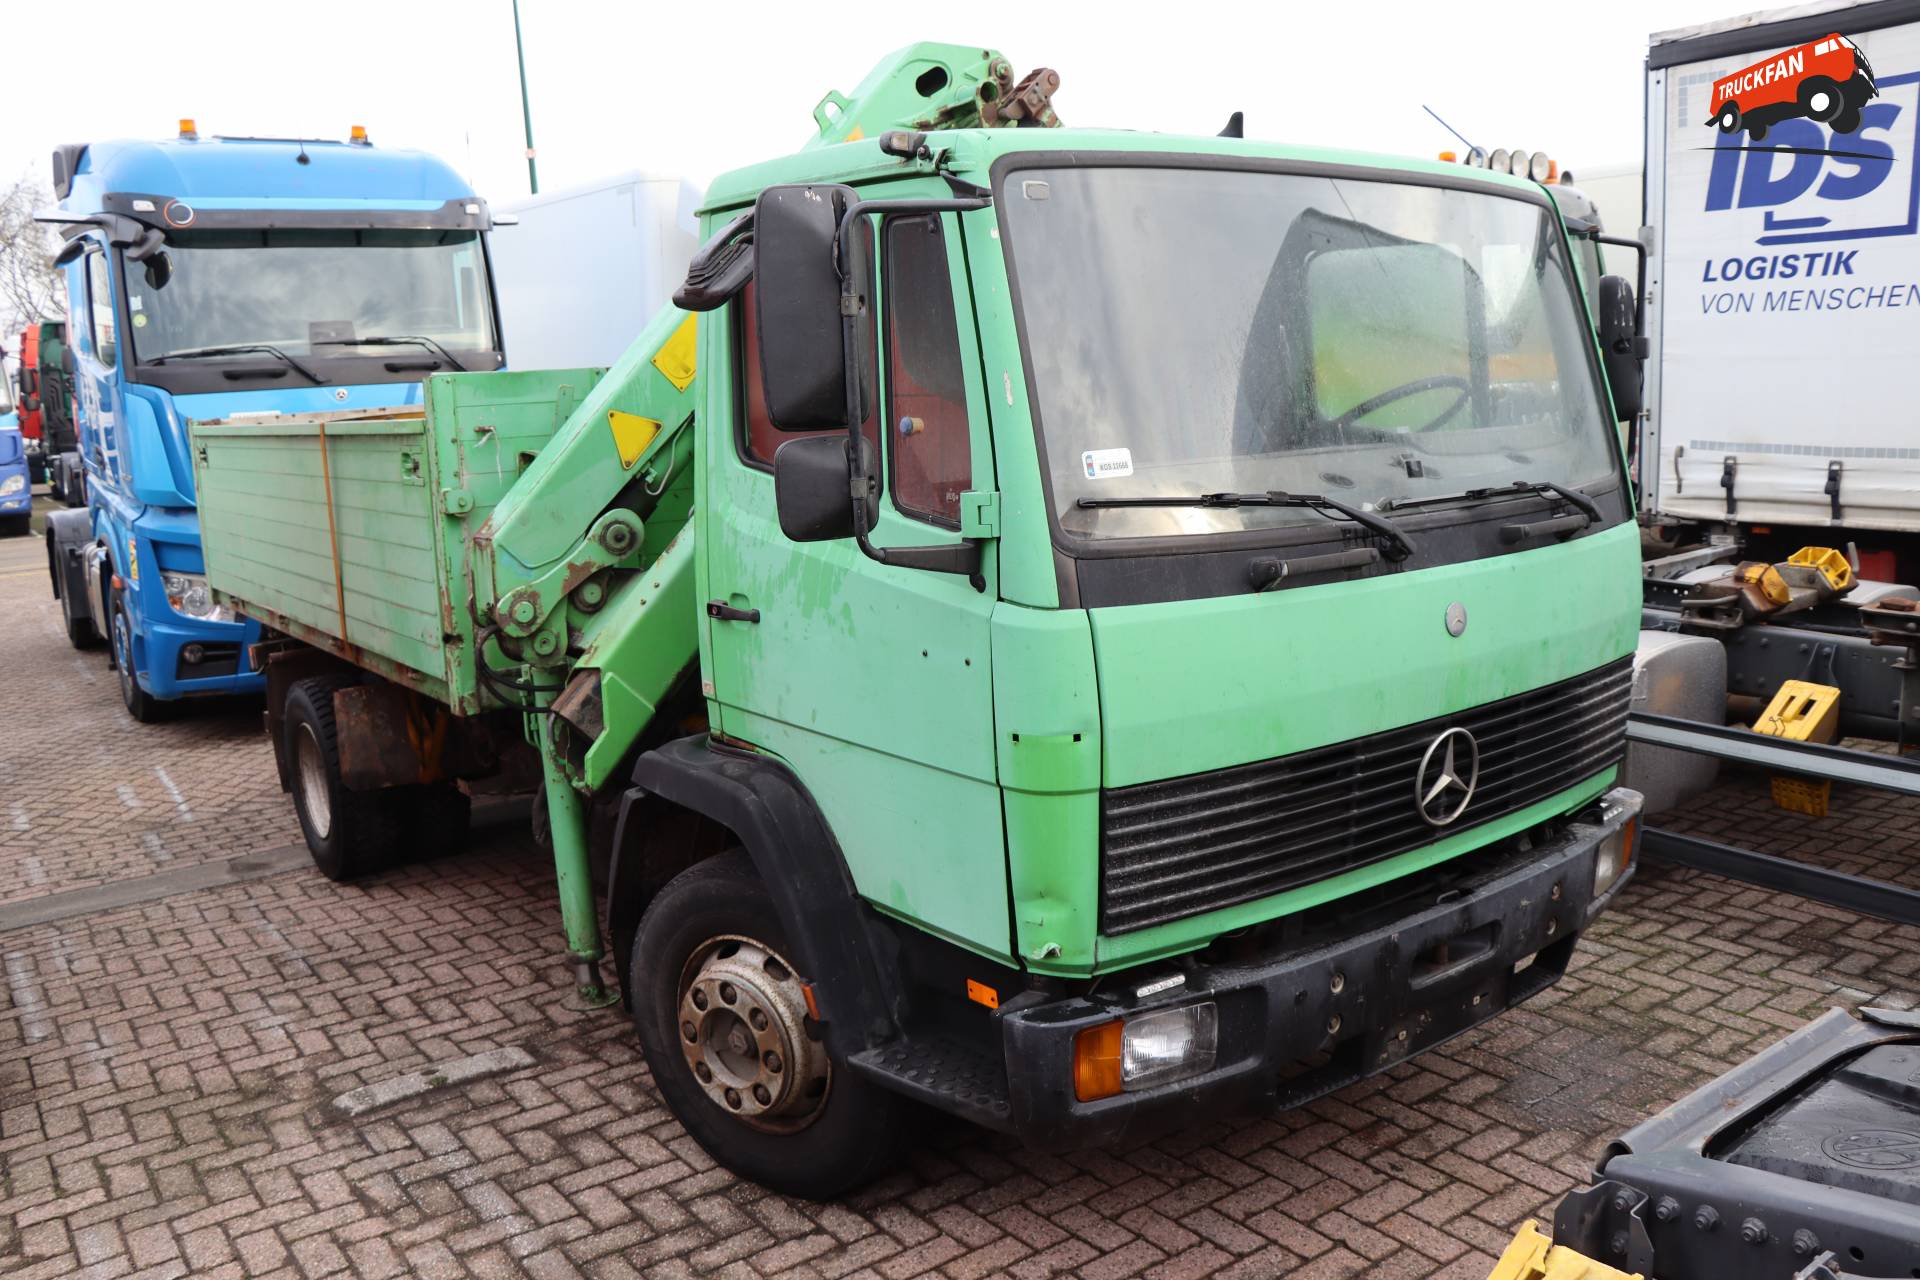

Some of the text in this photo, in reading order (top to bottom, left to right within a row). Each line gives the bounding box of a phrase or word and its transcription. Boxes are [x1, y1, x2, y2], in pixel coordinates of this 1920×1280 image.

[1704, 103, 1903, 212] IDS
[1702, 250, 1859, 283] LOGISTIK
[1701, 292, 1754, 314] VON
